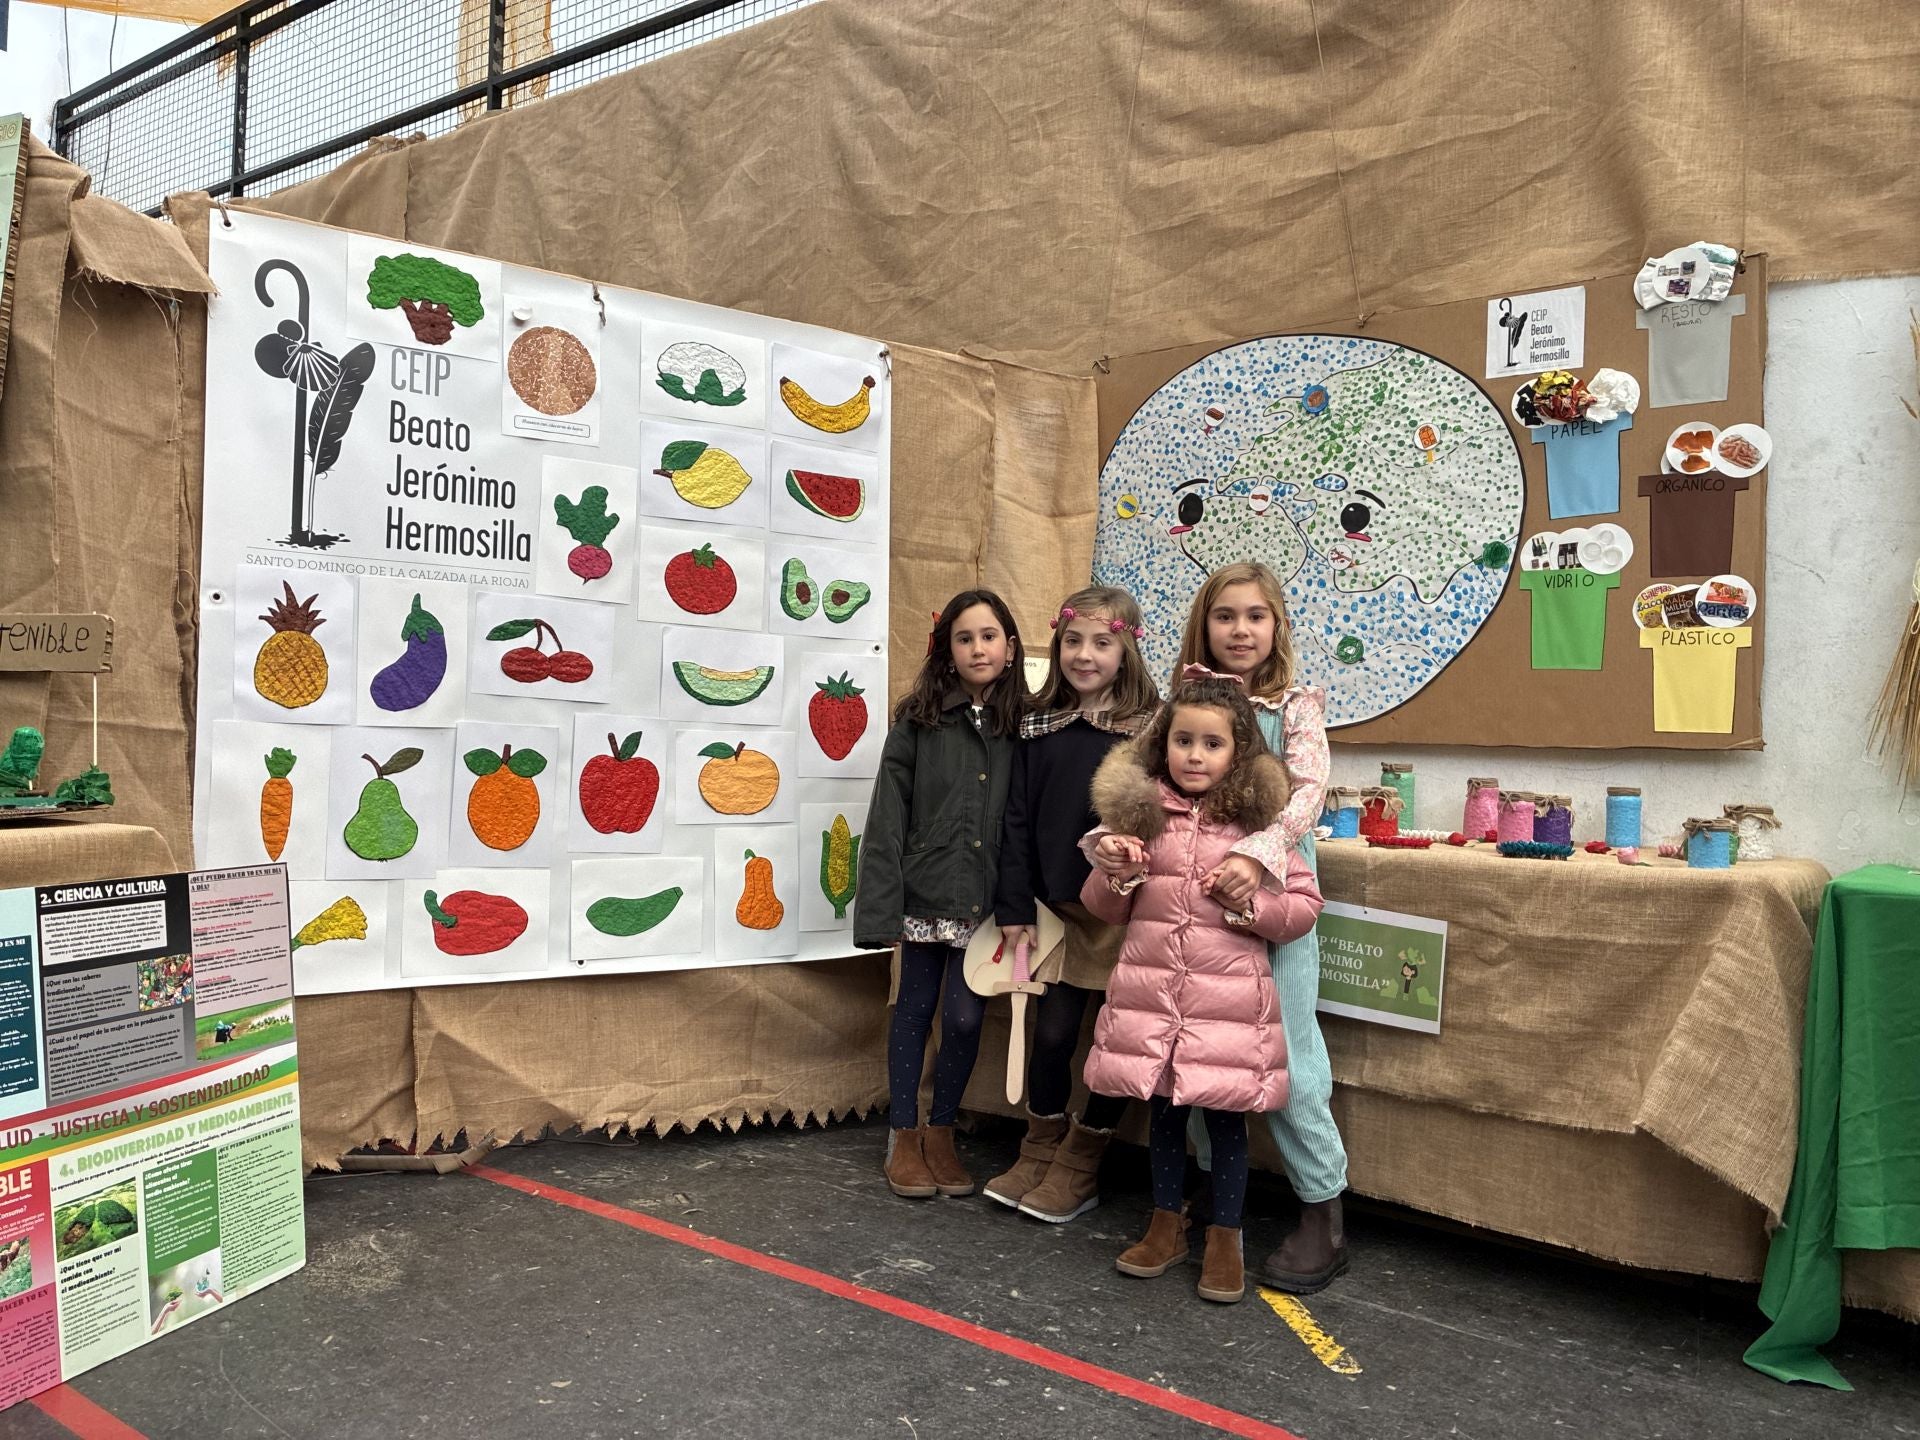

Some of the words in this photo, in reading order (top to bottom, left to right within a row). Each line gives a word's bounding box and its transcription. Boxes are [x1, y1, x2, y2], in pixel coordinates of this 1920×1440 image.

[1531, 308, 1548, 322] CEIP
[1661, 302, 1712, 324] RESTO
[1531, 323, 1553, 336] Beato
[1530, 336, 1566, 350] Jerónimo
[1529, 349, 1570, 364] Hermosilla
[391, 347, 452, 397] CEIP
[389, 400, 471, 452] Beato
[1551, 420, 1603, 440] PAPEL
[386, 453, 516, 510] Jerónimo
[385, 506, 531, 563] Hermosilla
[246, 553, 294, 568] SANTO
[298, 559, 366, 575] DOMINGO
[369, 565, 386, 576] DE
[390, 567, 405, 578] LA
[408, 569, 467, 584] CALZADA
[469, 574, 487, 586] (LA
[491, 575, 530, 589] RIOJA)
[1543, 573, 1594, 589] VIDRIO
[1665, 600, 1694, 613] MILHO
[227, 870, 245, 879] HACER
[40, 893, 52, 905] 2.
[54, 886, 103, 903] CIENCIA
[105, 884, 115, 897] Y
[116, 879, 167, 896] CULTURA
[1330, 936, 1383, 958] “BEATO
[81, 973, 102, 982] saberes
[1319, 967, 1390, 990] MOSILLA”
[46, 985, 86, 997] tradicionales?
[79, 1030, 95, 1041] papel
[110, 1022, 126, 1032] mujer
[51, 1108, 130, 1140] JUSTICIA
[134, 1104, 144, 1121] Y
[149, 1064, 271, 1118] SOSTENIBILIDAD
[59, 1163, 75, 1178] 4.
[77, 1126, 185, 1173] BIODIVERSIDAD
[186, 1122, 196, 1138] Y
[198, 1091, 297, 1134] MEDIOAMBIENTE.
[76, 1258, 91, 1268] tiene
[92, 1254, 102, 1263] que
[114, 1245, 121, 1253] mi
[61, 1271, 82, 1284] comida
[68, 1267, 115, 1291] medioambiente?
[38, 1288, 49, 1297] EN
